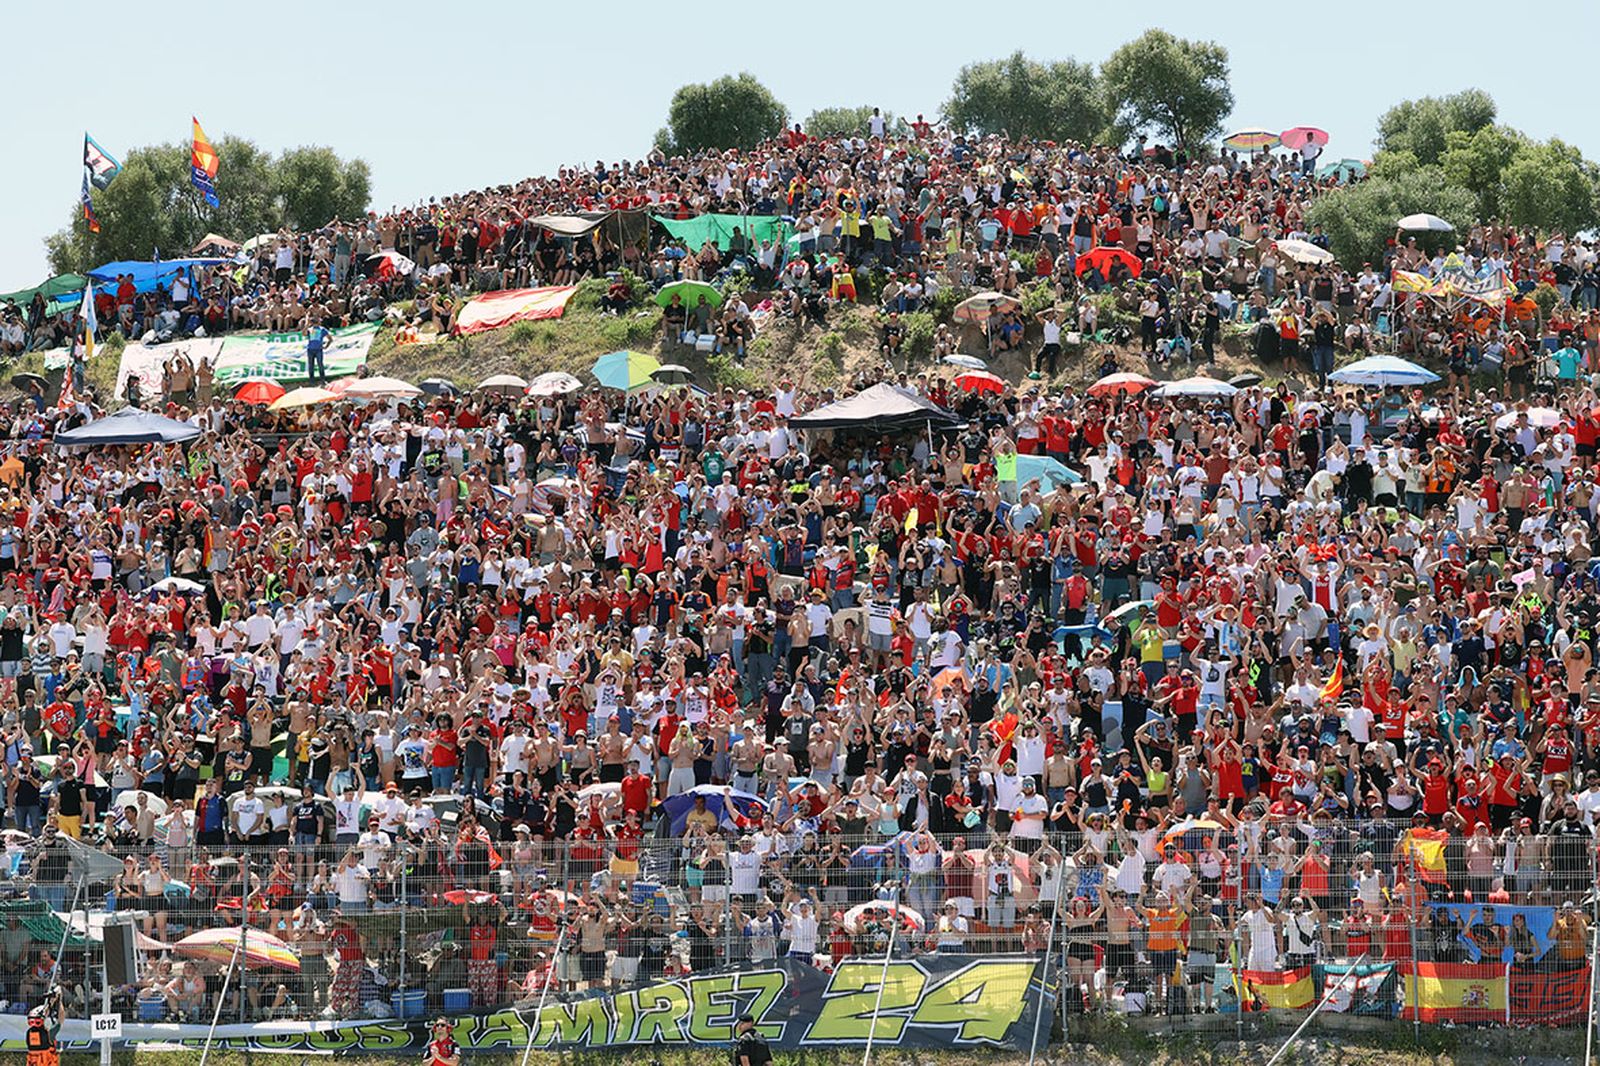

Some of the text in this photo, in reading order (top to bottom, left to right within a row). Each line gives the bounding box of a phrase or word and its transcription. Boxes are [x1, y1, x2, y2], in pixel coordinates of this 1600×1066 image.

[95, 1018, 117, 1031] LC12
[424, 967, 787, 1050] RAMIREZ
[800, 957, 1041, 1046] 24
